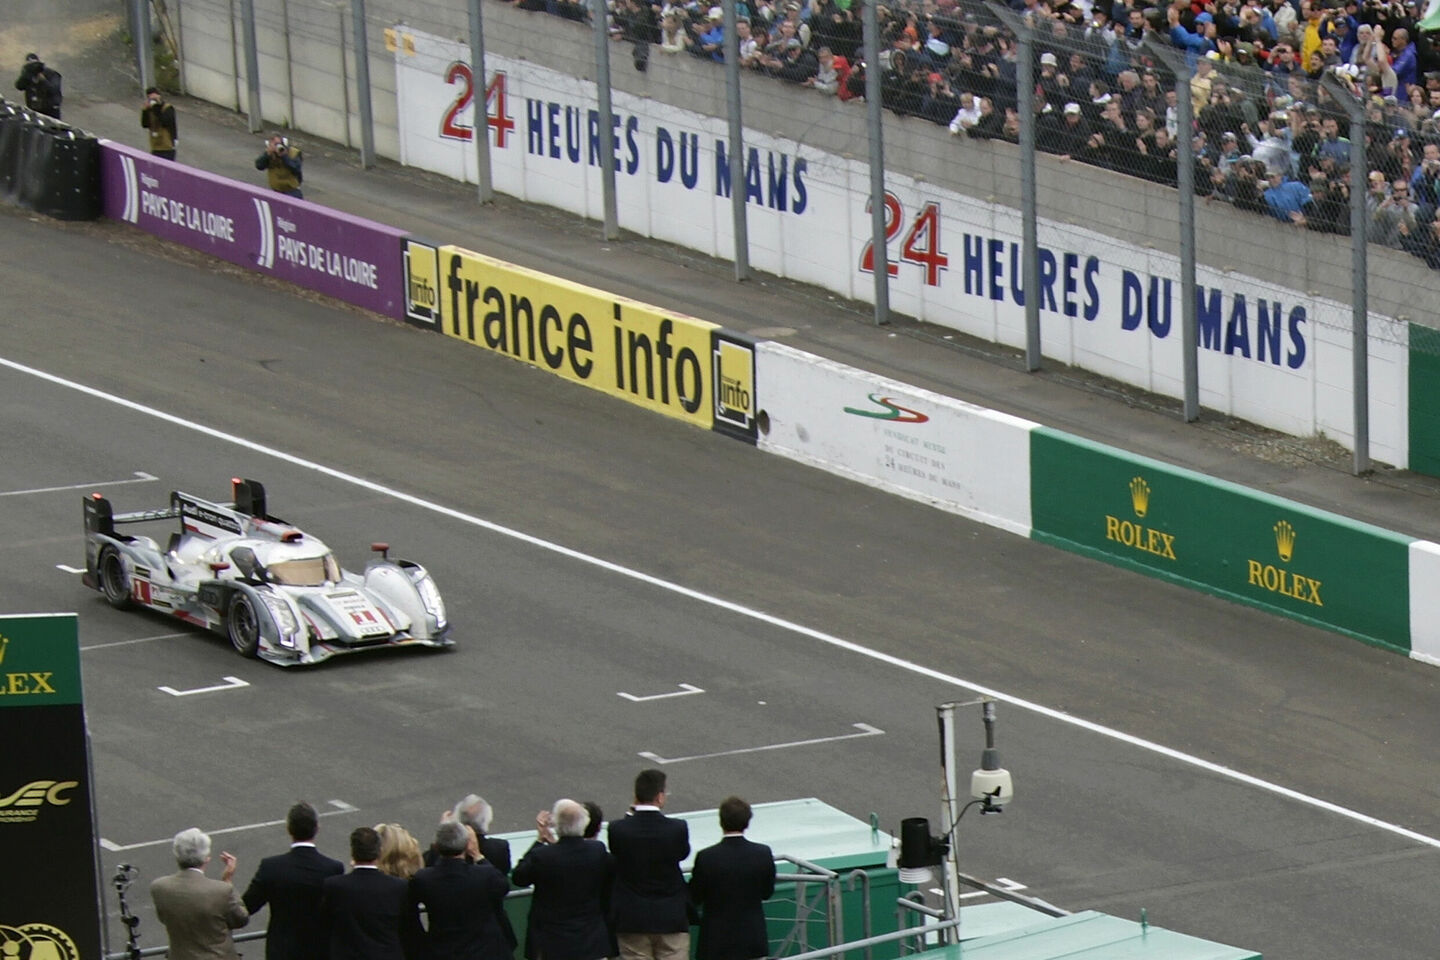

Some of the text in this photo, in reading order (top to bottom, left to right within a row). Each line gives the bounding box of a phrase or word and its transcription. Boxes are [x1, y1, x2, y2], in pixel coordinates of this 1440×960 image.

[440, 60, 808, 216] 24 HEURES DU MANS
[142, 190, 235, 243] PAYS DE LA LOIRE
[278, 235, 378, 290] PAYS DE LA LOIRE
[858, 189, 1307, 370] 24 HEURES DU MANS
[448, 254, 702, 415] france info
[1105, 515, 1177, 561] ROLEX
[1247, 559, 1323, 607] ROLEX
[0, 672, 56, 695] EX
